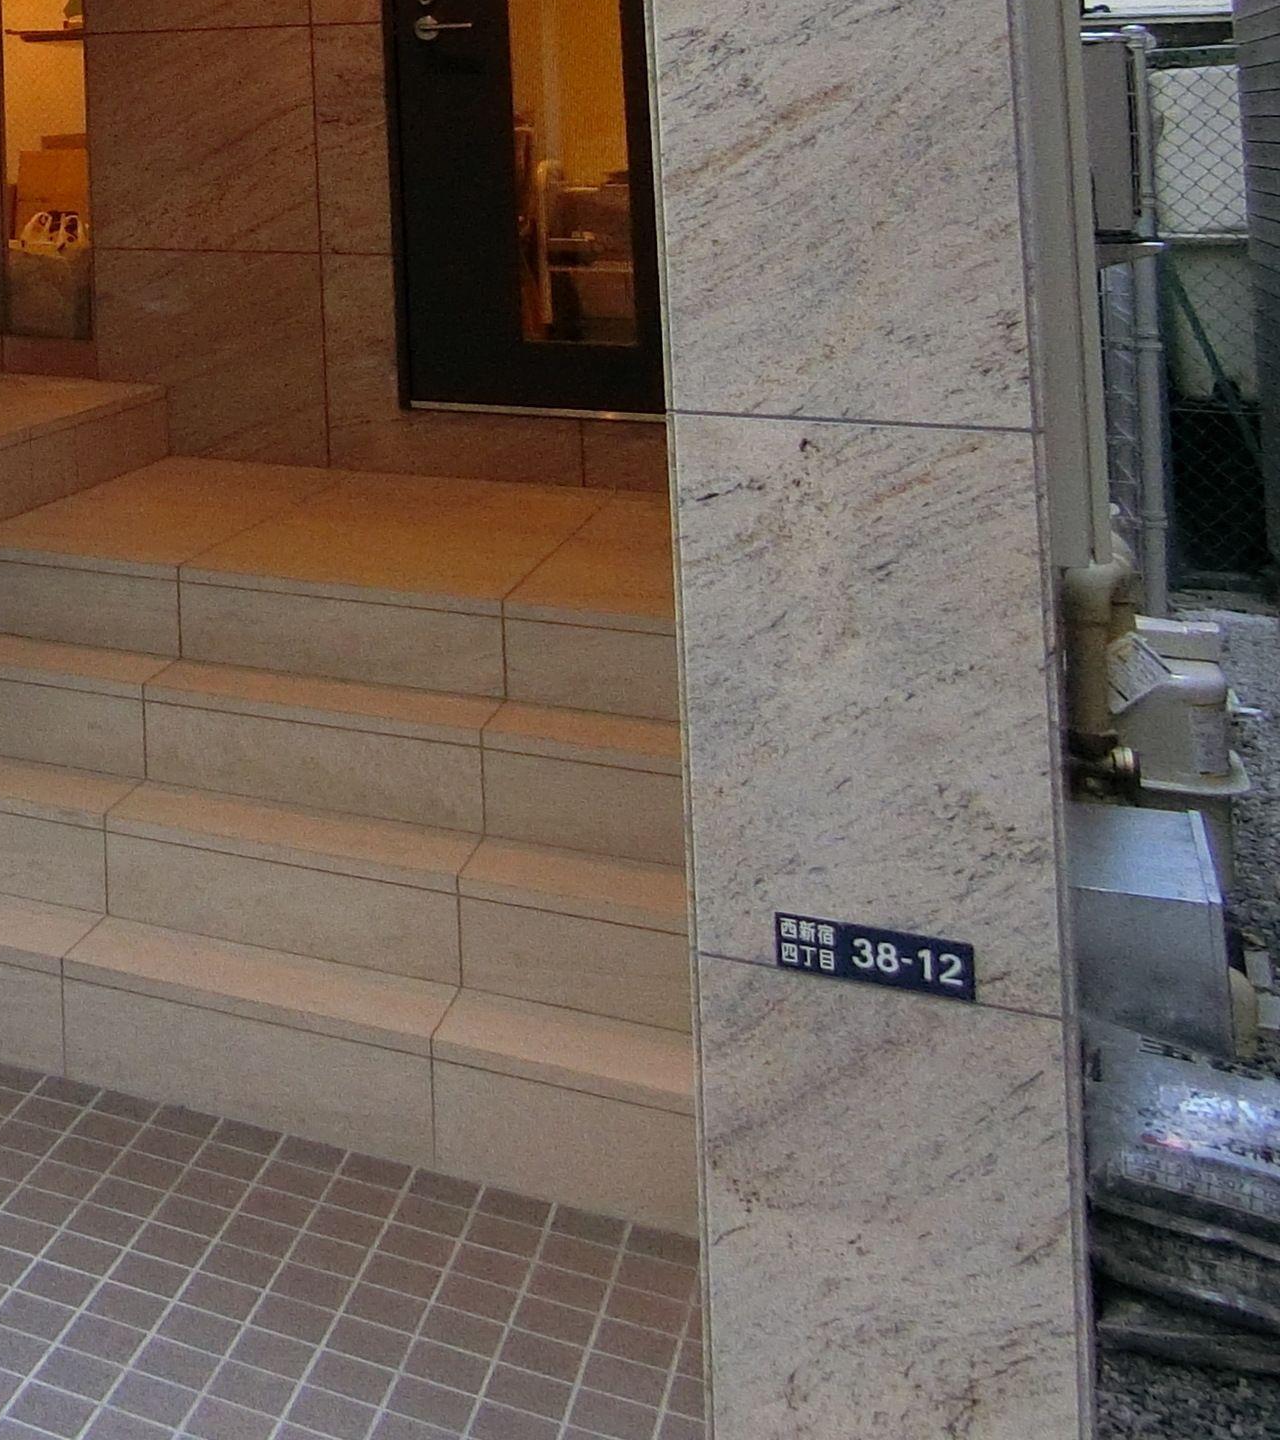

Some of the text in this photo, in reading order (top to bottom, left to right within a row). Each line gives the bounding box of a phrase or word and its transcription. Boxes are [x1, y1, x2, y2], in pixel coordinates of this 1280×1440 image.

[779, 917, 835, 947] 西新宿
[781, 942, 835, 971] 四丁目
[851, 937, 965, 987] 38-12
